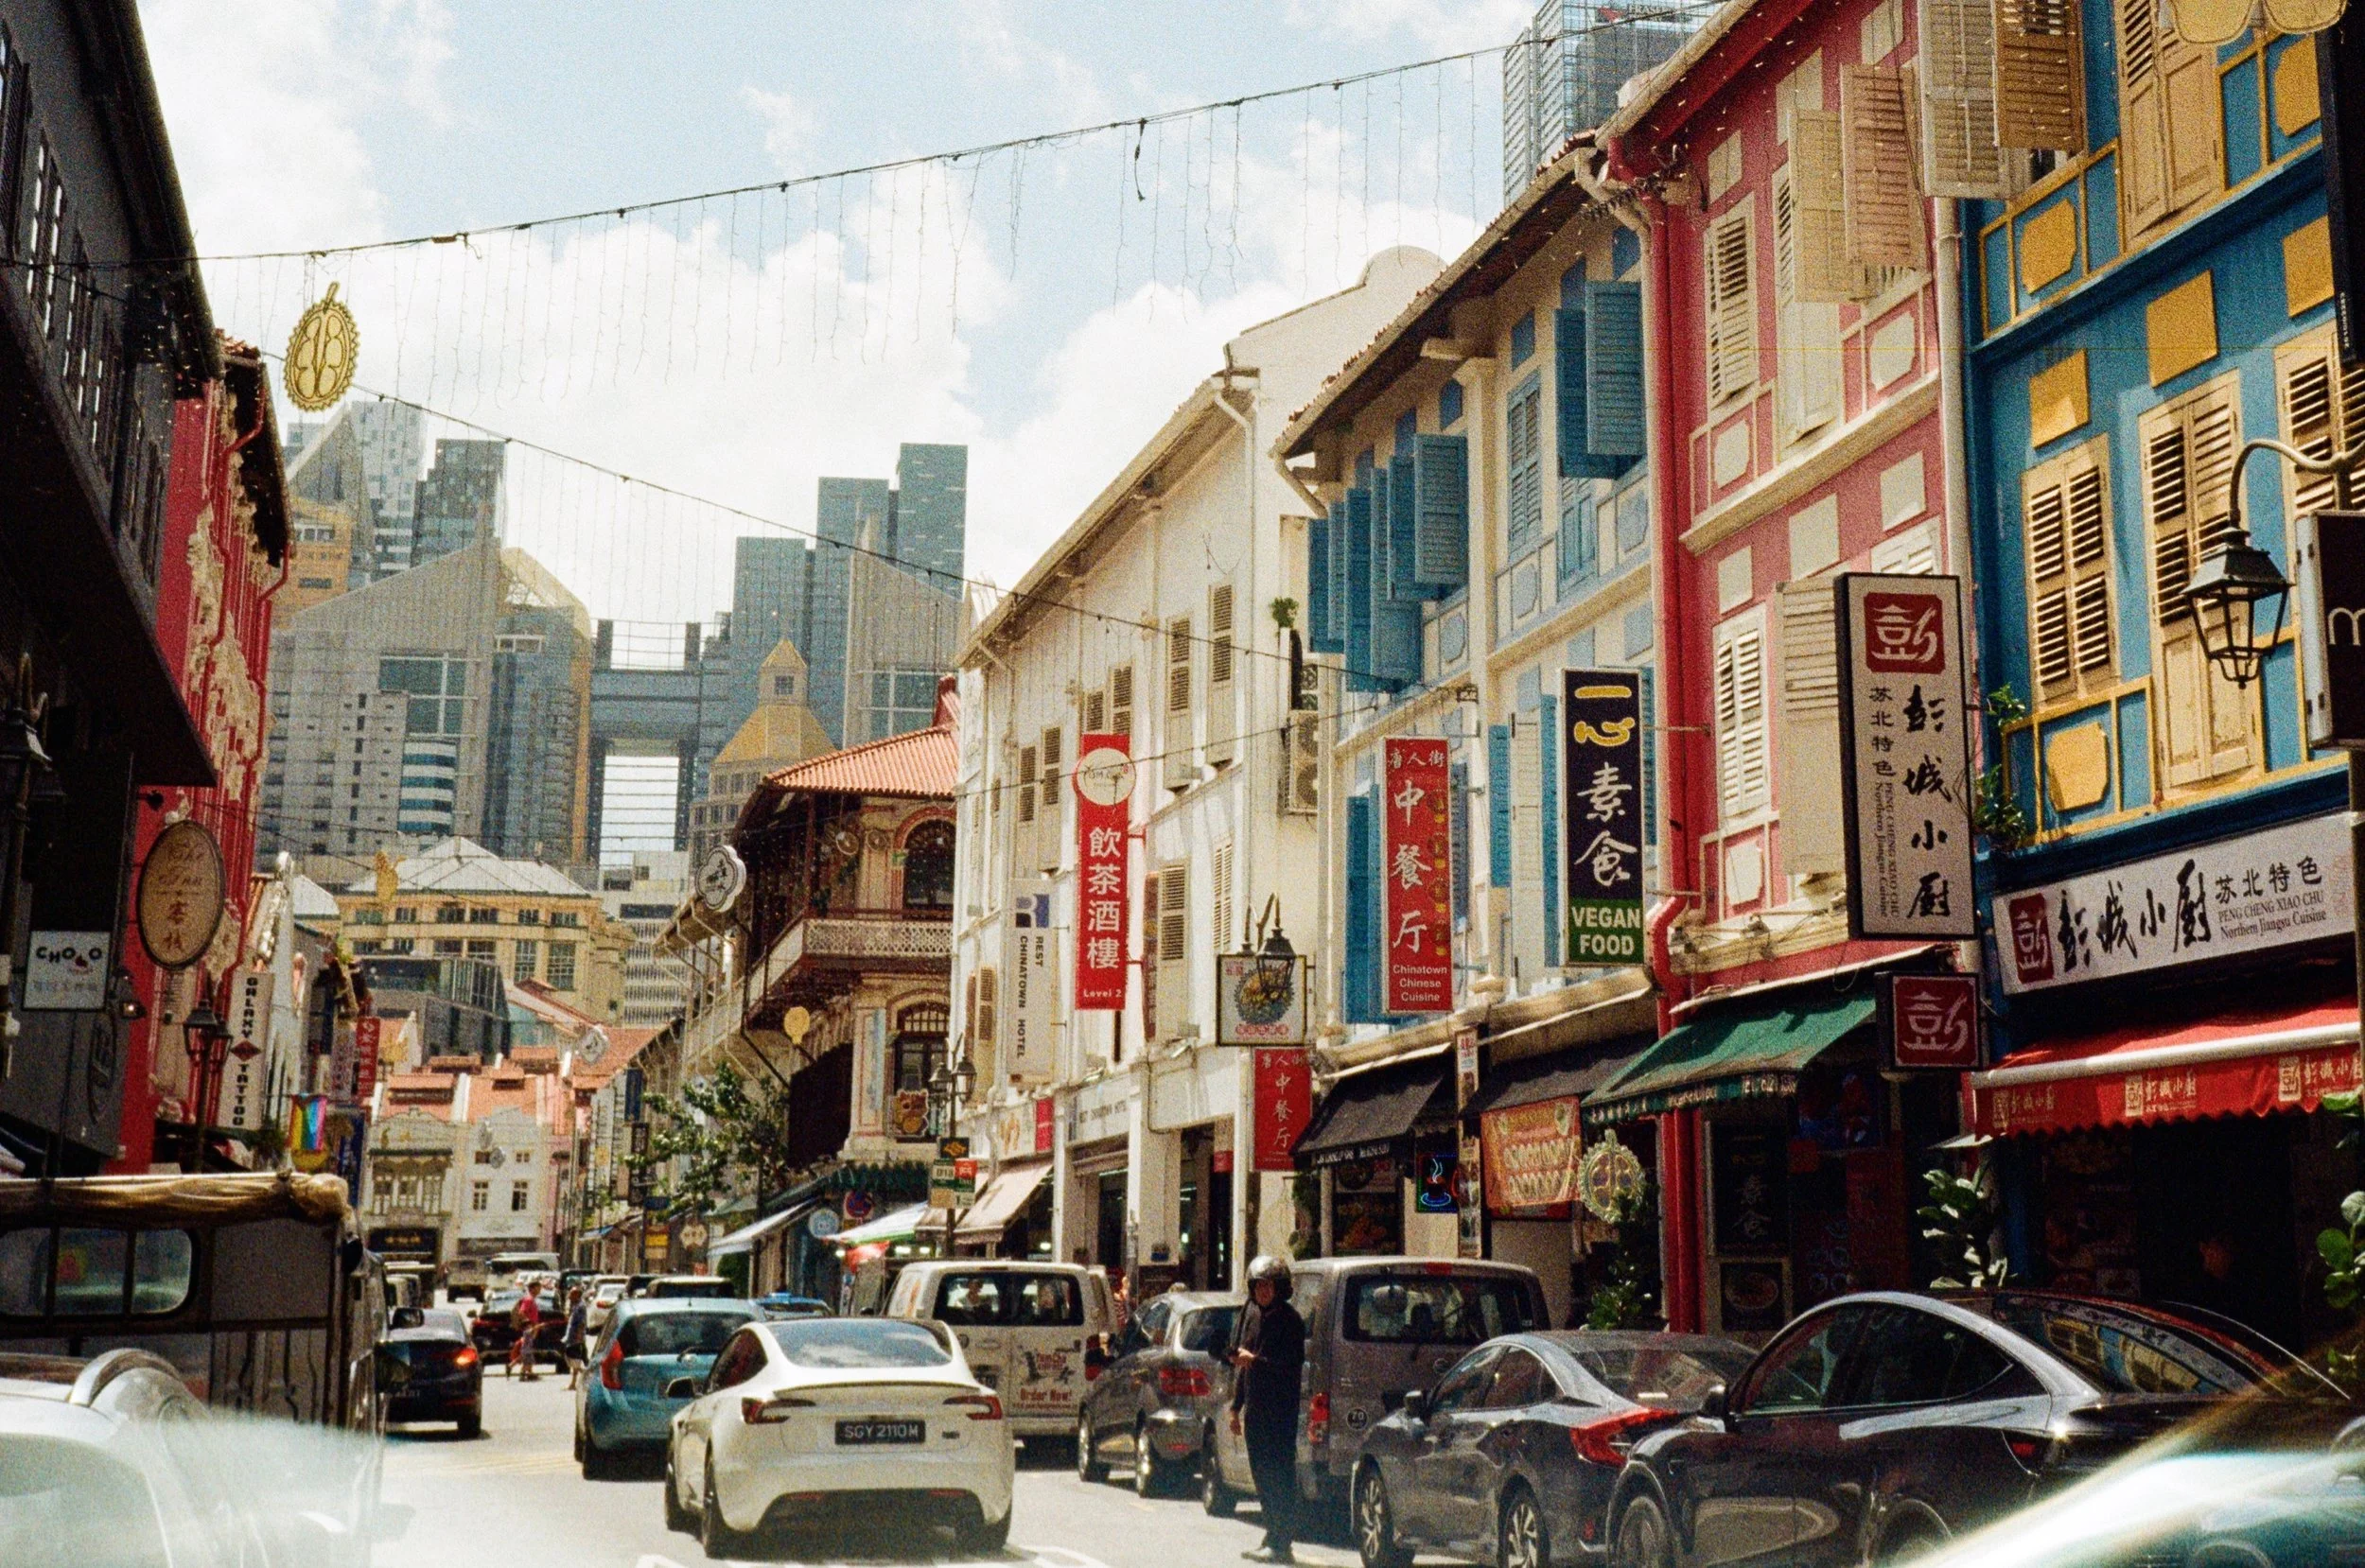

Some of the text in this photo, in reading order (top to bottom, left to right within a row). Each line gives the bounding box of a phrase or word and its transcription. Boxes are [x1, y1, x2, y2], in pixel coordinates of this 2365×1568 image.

[1869, 688, 1896, 777] 苏北特色
[1391, 779, 1432, 954] 中餐厅
[2215, 856, 2322, 904] 苏北特色
[1087, 827, 1122, 969] 飲茶酒樓
[2218, 889, 2324, 922] PENG CHENG XIAO CHU
[1571, 907, 1640, 929] VEGAN
[2220, 908, 2327, 939] Northern Jiangsu Cuisine
[1035, 935, 1043, 967] REST
[1579, 933, 1634, 955] FOOD
[1393, 965, 1446, 974] Chinatown
[1400, 978, 1441, 987] Chinese
[1017, 935, 1028, 1058] CHINATOWN HOTEL
[1083, 989, 1122, 998] Level 2
[1401, 991, 1440, 1002] Cuisine
[233, 1063, 249, 1126] TATTOO
